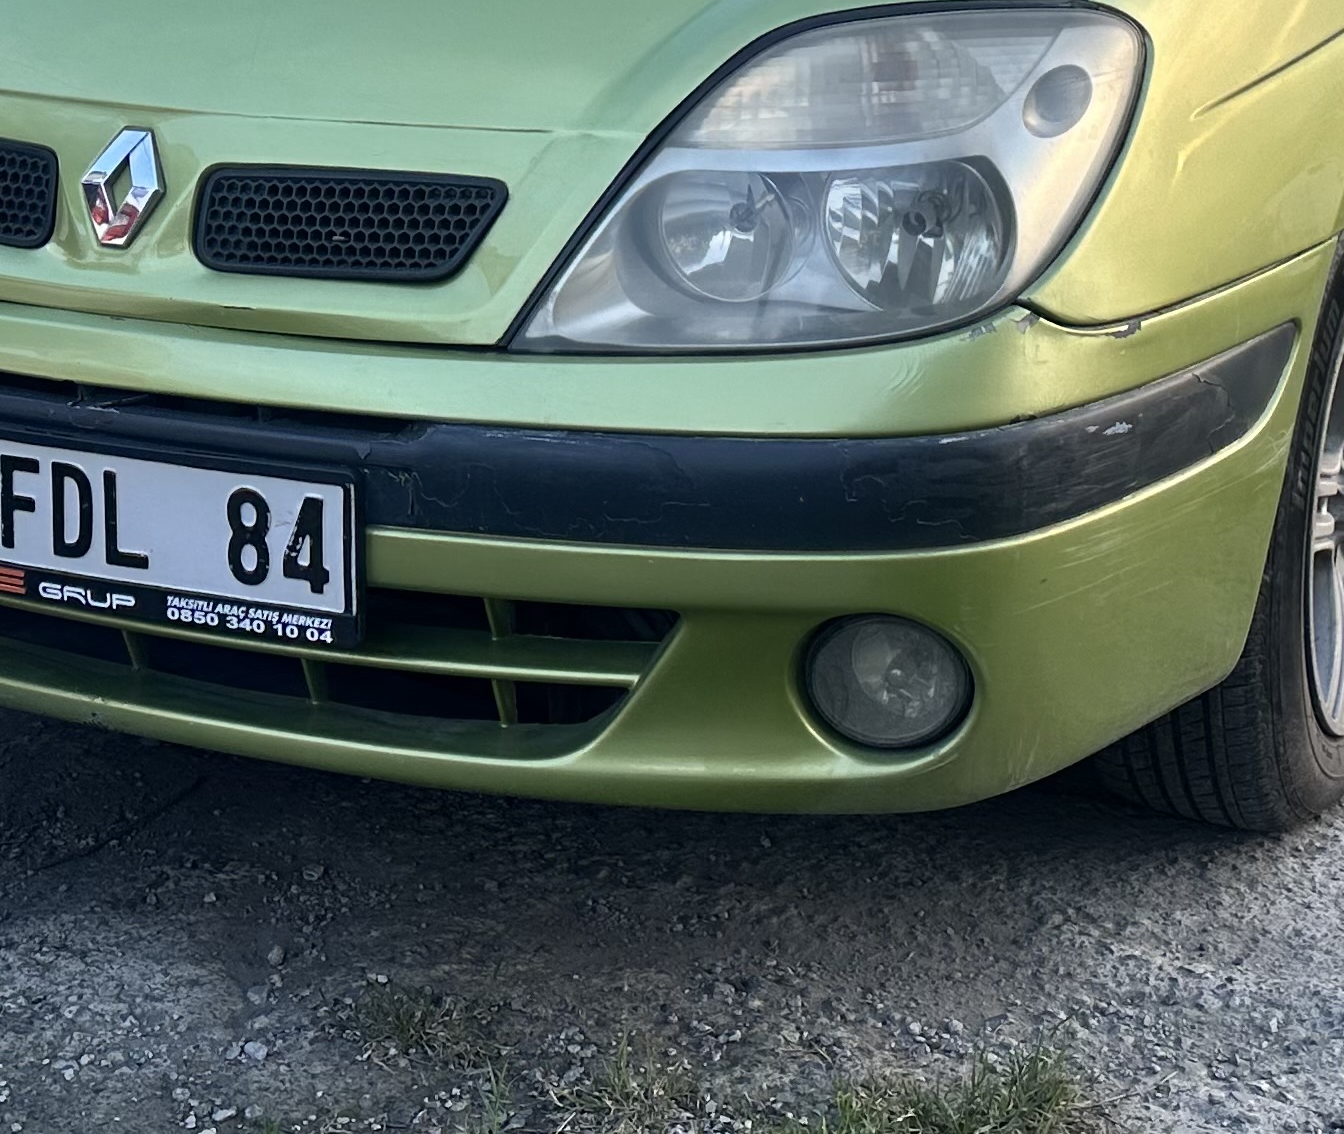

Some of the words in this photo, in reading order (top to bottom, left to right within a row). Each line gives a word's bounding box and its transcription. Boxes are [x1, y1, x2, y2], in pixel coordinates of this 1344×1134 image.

[0, 454, 149, 570] FDL
[226, 487, 330, 594] 84
[38, 580, 136, 610] GRUP
[166, 607, 219, 626] 0850
[226, 616, 265, 634] 340
[272, 623, 299, 638] 10
[305, 628, 334, 644] 04
